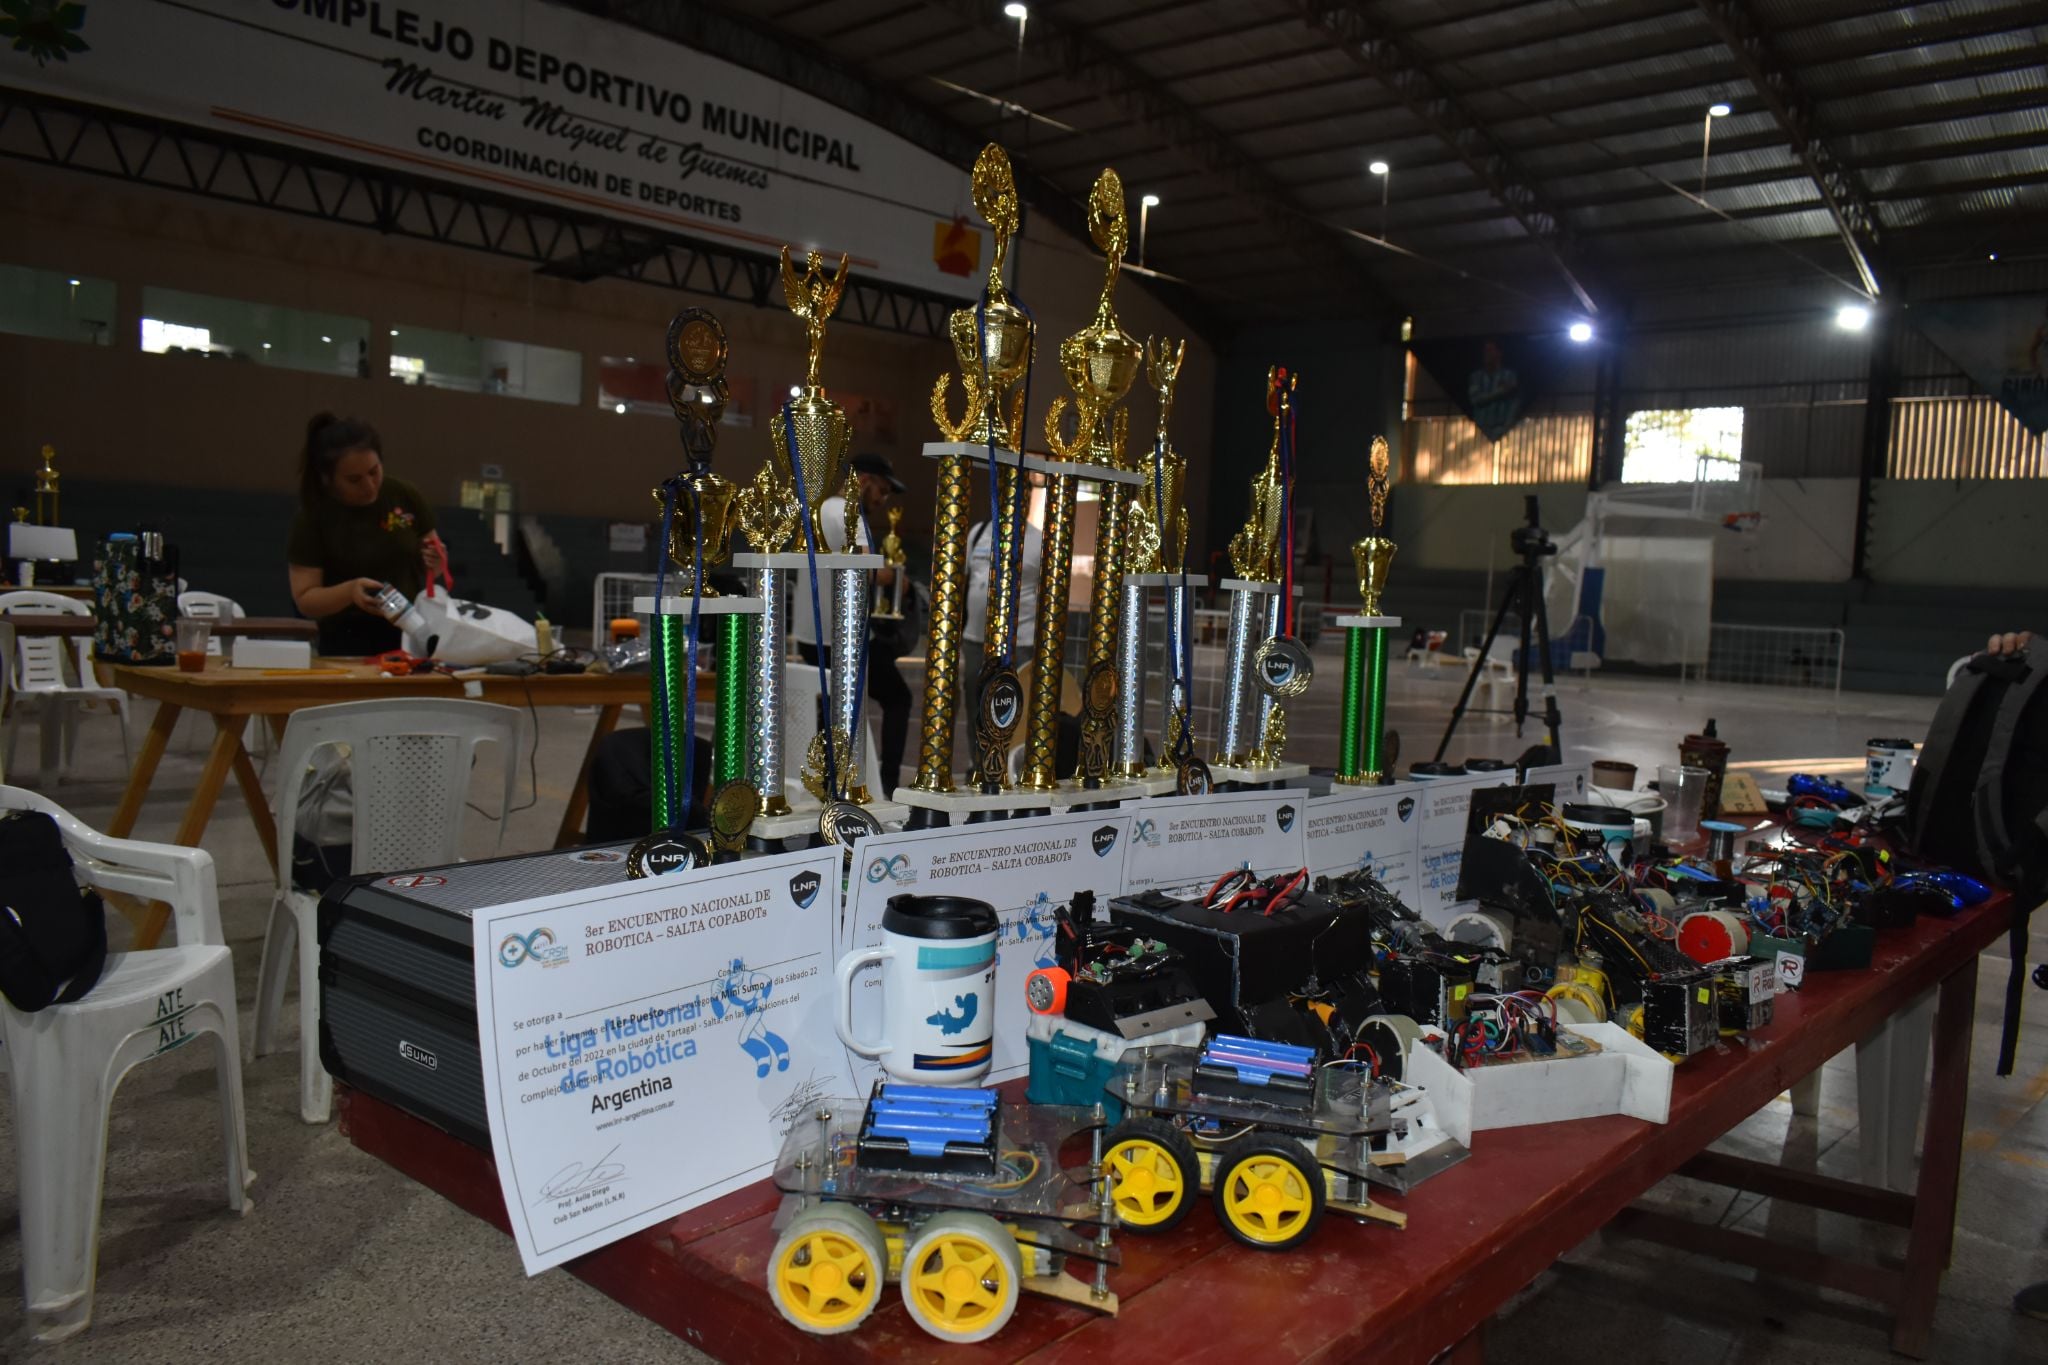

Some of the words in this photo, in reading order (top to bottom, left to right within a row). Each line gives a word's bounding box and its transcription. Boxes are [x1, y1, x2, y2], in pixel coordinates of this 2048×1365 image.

[272, 0, 474, 61] MPLEJO
[489, 37, 692, 124] DEPORTIVO
[703, 102, 860, 172] MUNICIPAL
[519, 97, 630, 152] Miguel
[638, 135, 668, 164] de
[417, 127, 598, 190] COORDINACIÓN
[605, 174, 633, 198] DE
[639, 181, 741, 223] DEPORTES
[1267, 660, 1290, 670] LNR
[995, 697, 1012, 707] LNR
[1180, 816, 1221, 830] ENCUENTRO
[1223, 813, 1256, 828] NACIONAL
[1257, 813, 1266, 824] DE
[1278, 812, 1293, 820] LNR
[1308, 814, 1347, 829] ENCUENTRO
[1348, 808, 1378, 821] NACIONAL
[1380, 806, 1389, 816] DE
[840, 825, 866, 835] LNR
[1094, 833, 1115, 844] LNR
[1168, 830, 1203, 844] ROBOTICA
[1209, 828, 1230, 840] SALTA
[1335, 825, 1354, 835] SALTA
[651, 854, 684, 863] LNR
[931, 854, 947, 866] 3er
[949, 846, 1011, 863] ENCUENTRO
[1013, 839, 1062, 856] NACIONAL
[1062, 837, 1078, 849] DE
[929, 864, 982, 880] ROBOTICA
[991, 858, 1022, 872] SALTA
[792, 880, 818, 893] LNR
[585, 924, 605, 938] 3er
[608, 905, 688, 934] ENCUENTRO
[691, 892, 753, 916] NACIONAL
[755, 888, 771, 902] DE
[586, 930, 654, 957] ROBOTICA
[666, 918, 705, 939] SALTA
[708, 906, 768, 930] COPABOTs
[157, 987, 184, 1018] ATE
[515, 1046, 531, 1058] por
[533, 1037, 559, 1052] haber
[560, 1027, 598, 1044] obtenido
[629, 1008, 664, 1025] Puesto
[742, 981, 765, 994] Sumo
[810, 966, 818, 976] 22
[160, 1015, 186, 1047] ATE
[513, 1020, 524, 1031] Se
[526, 1012, 555, 1027] otorga
[557, 1011, 563, 1019] a
[544, 1029, 597, 1060] Liga
[604, 994, 702, 1043] Nacional
[518, 1070, 530, 1082] de
[532, 1061, 567, 1078] Octubre
[568, 1057, 582, 1068] del
[584, 1049, 605, 1064] 2022
[606, 1045, 617, 1056] en
[618, 1041, 626, 1052] la
[627, 1034, 653, 1051] ciudad
[655, 1032, 665, 1043] de
[666, 1022, 697, 1040] Tartagal
[725, 1013, 734, 1022] en
[790, 993, 800, 1003] del
[401, 1040, 437, 1070] JSUMO
[560, 1068, 591, 1094] de
[595, 1038, 697, 1085] Robótica
[520, 1086, 562, 1105] Complejo
[591, 1076, 673, 1114] Argentina
